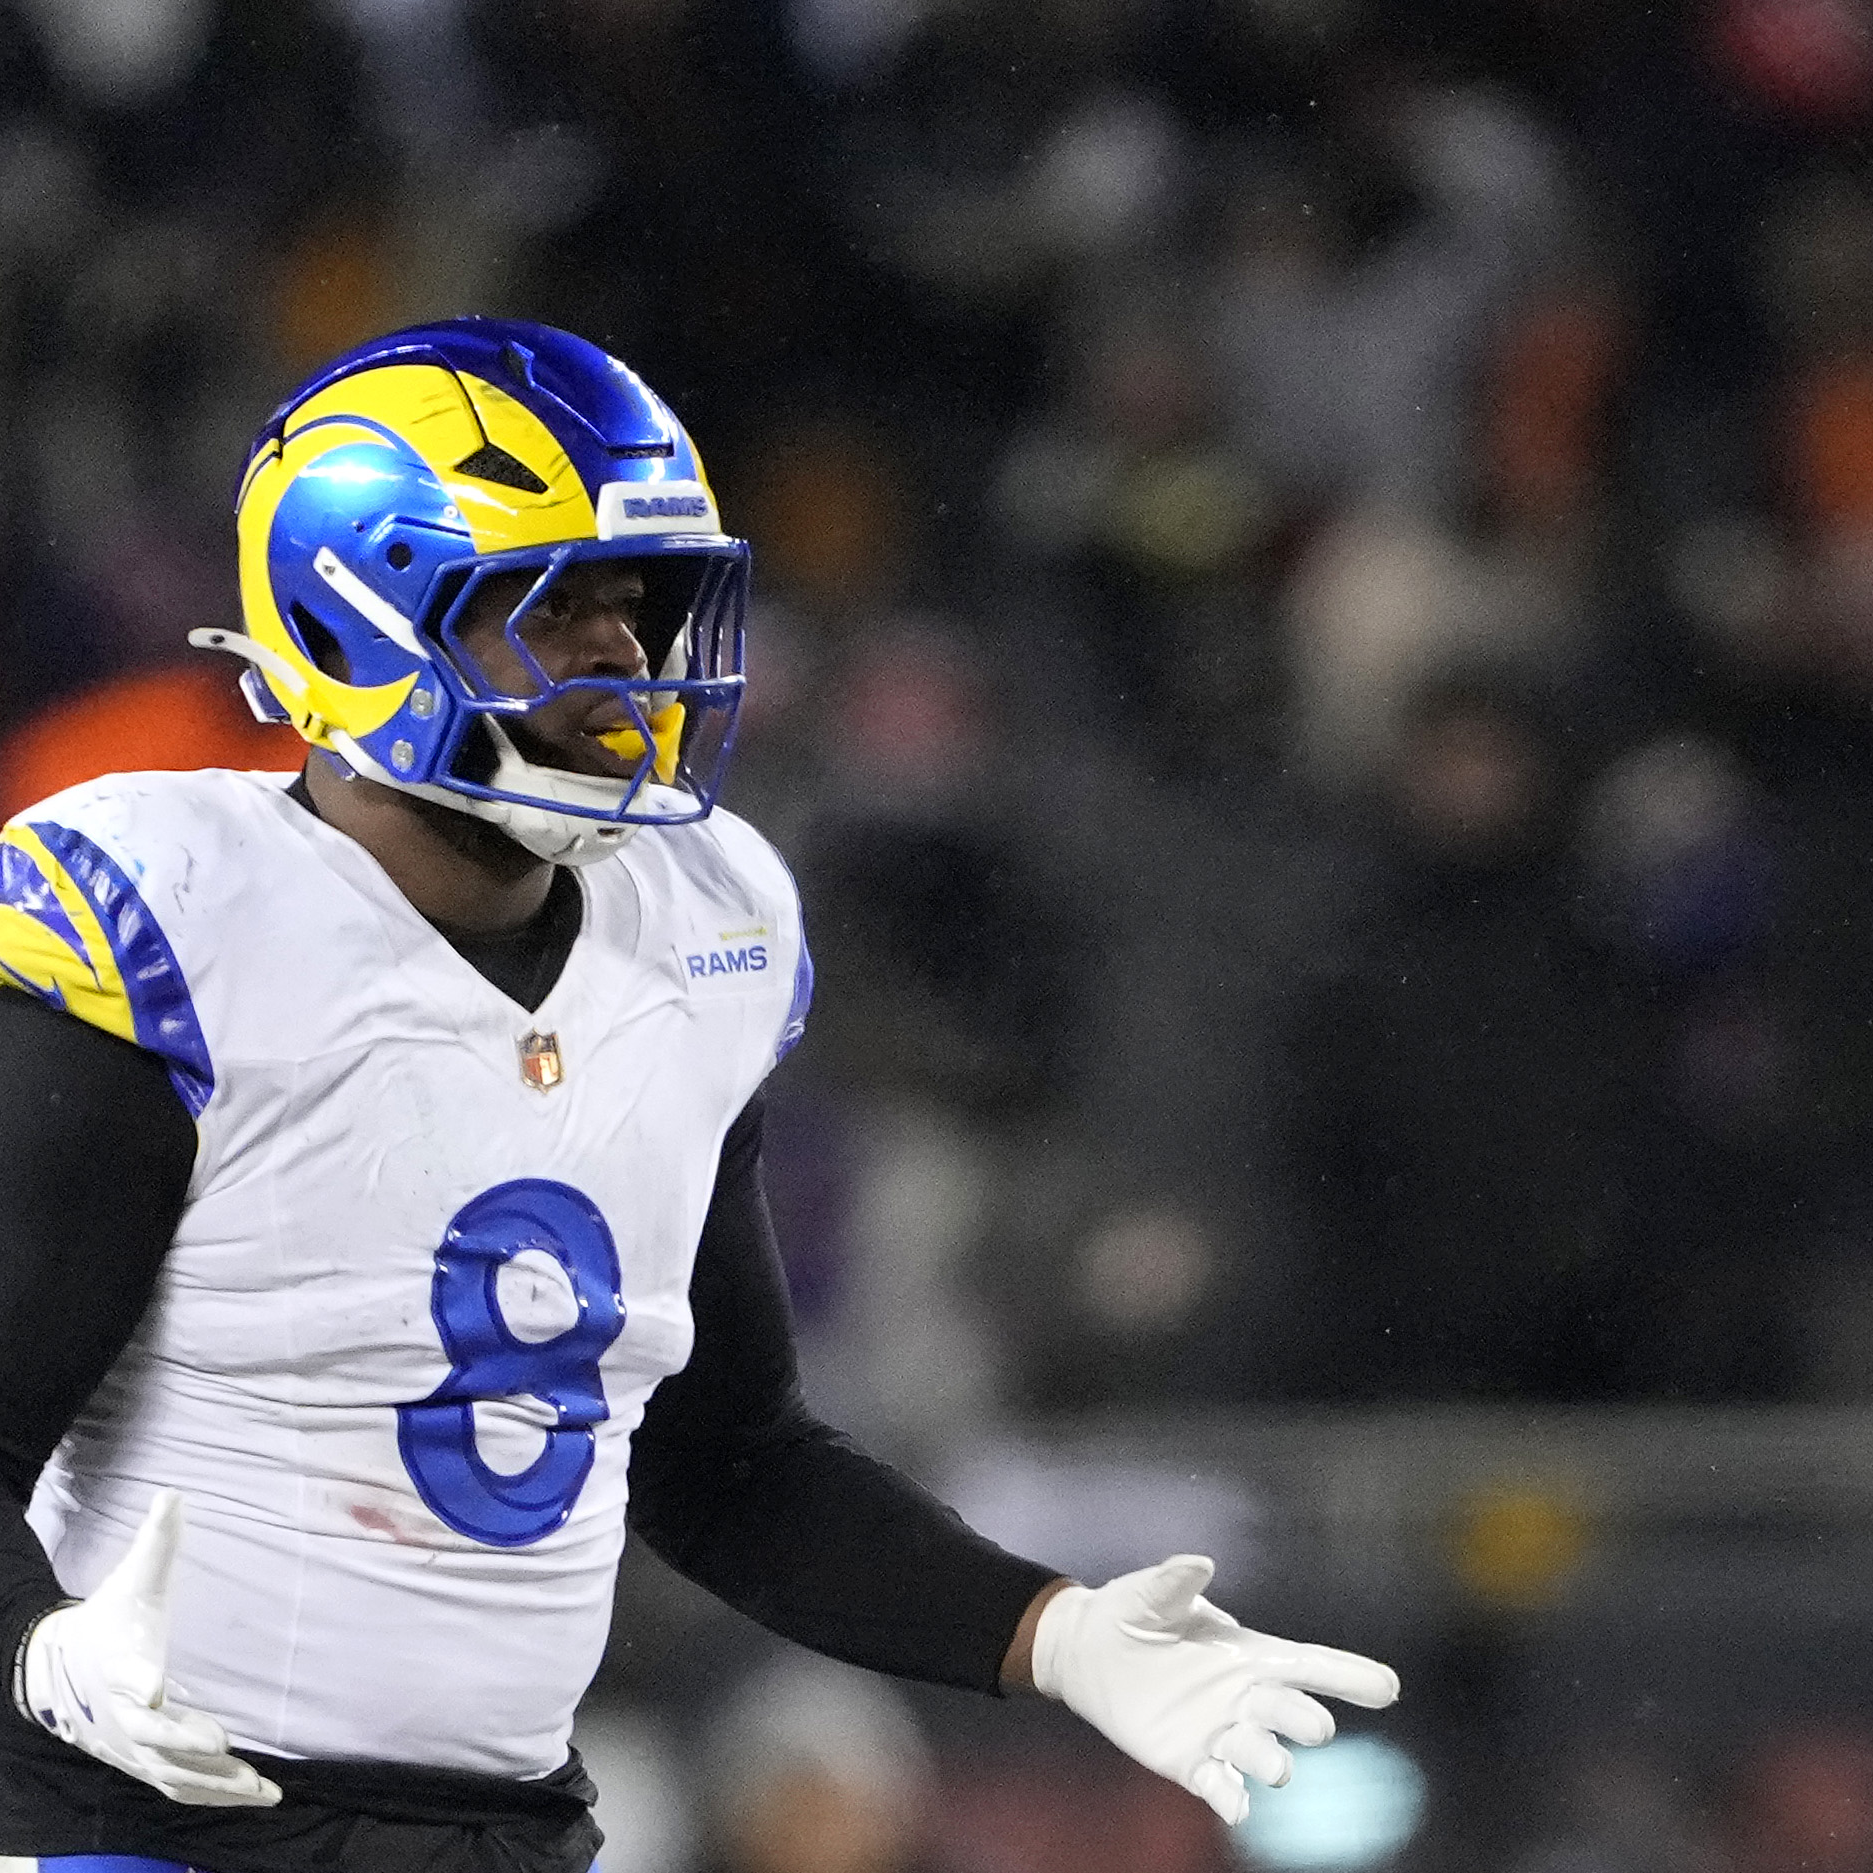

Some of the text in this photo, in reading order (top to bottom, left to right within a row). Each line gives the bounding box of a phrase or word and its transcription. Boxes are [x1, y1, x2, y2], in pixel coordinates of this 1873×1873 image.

[623, 496, 708, 519] RAMS
[686, 945, 767, 977] RAMS
[396, 1176, 627, 1548] 8
